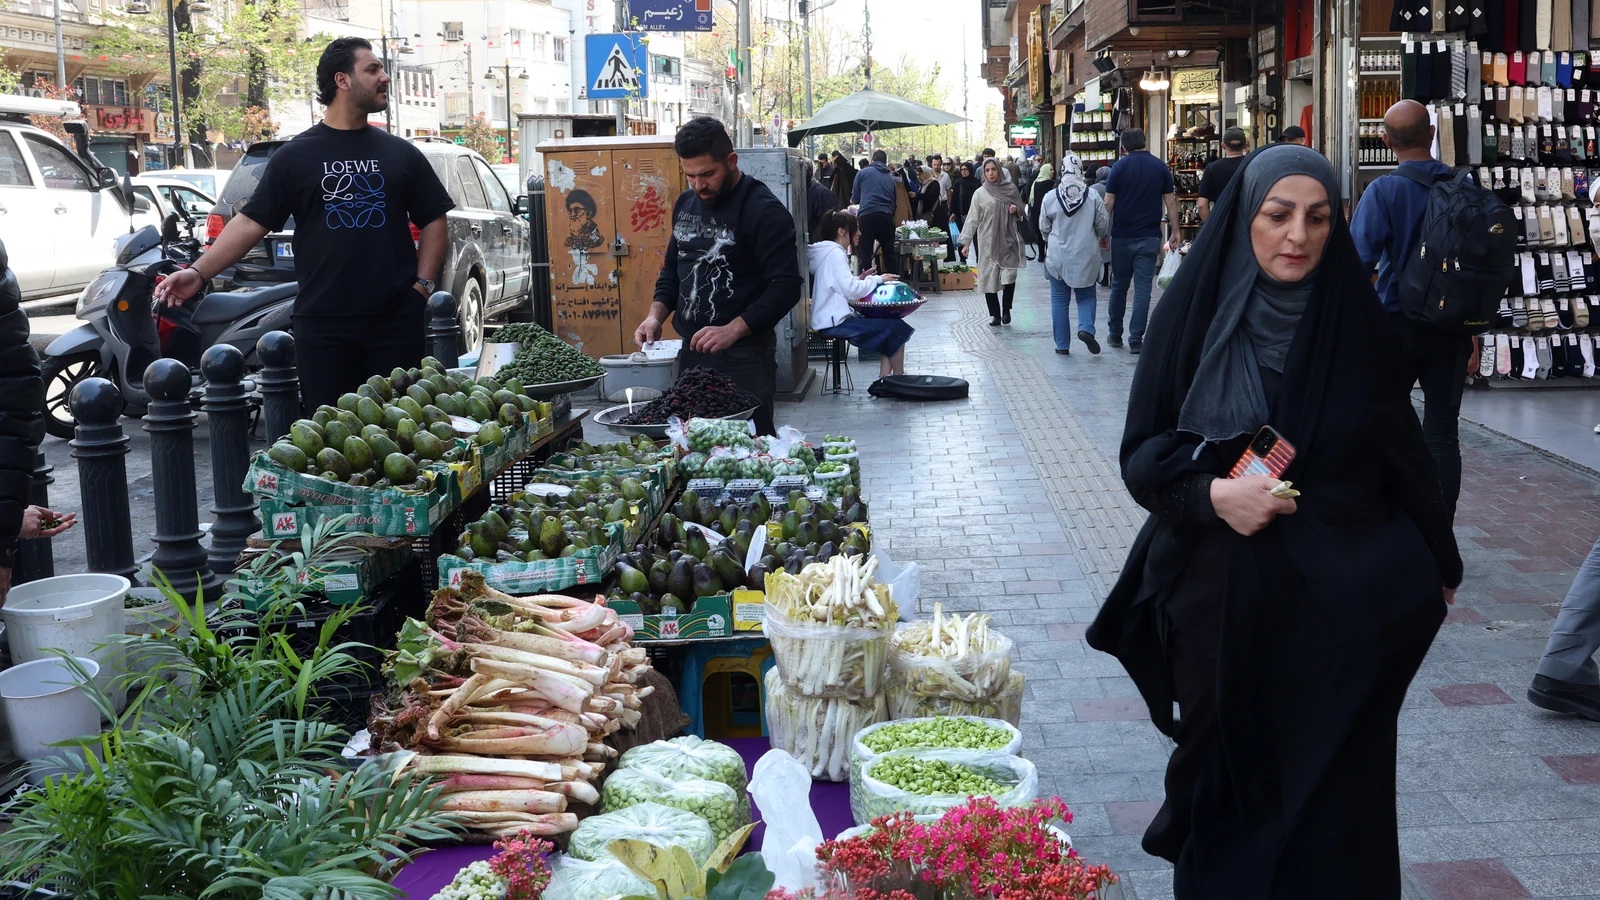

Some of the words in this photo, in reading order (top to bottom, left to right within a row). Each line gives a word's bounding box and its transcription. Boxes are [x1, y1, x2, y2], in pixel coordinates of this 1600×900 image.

[643, 4, 684, 21] زعیم
[323, 160, 380, 174] LOEWE
[257, 474, 278, 490] AK
[275, 515, 297, 532] AK
[661, 623, 679, 636] AK
